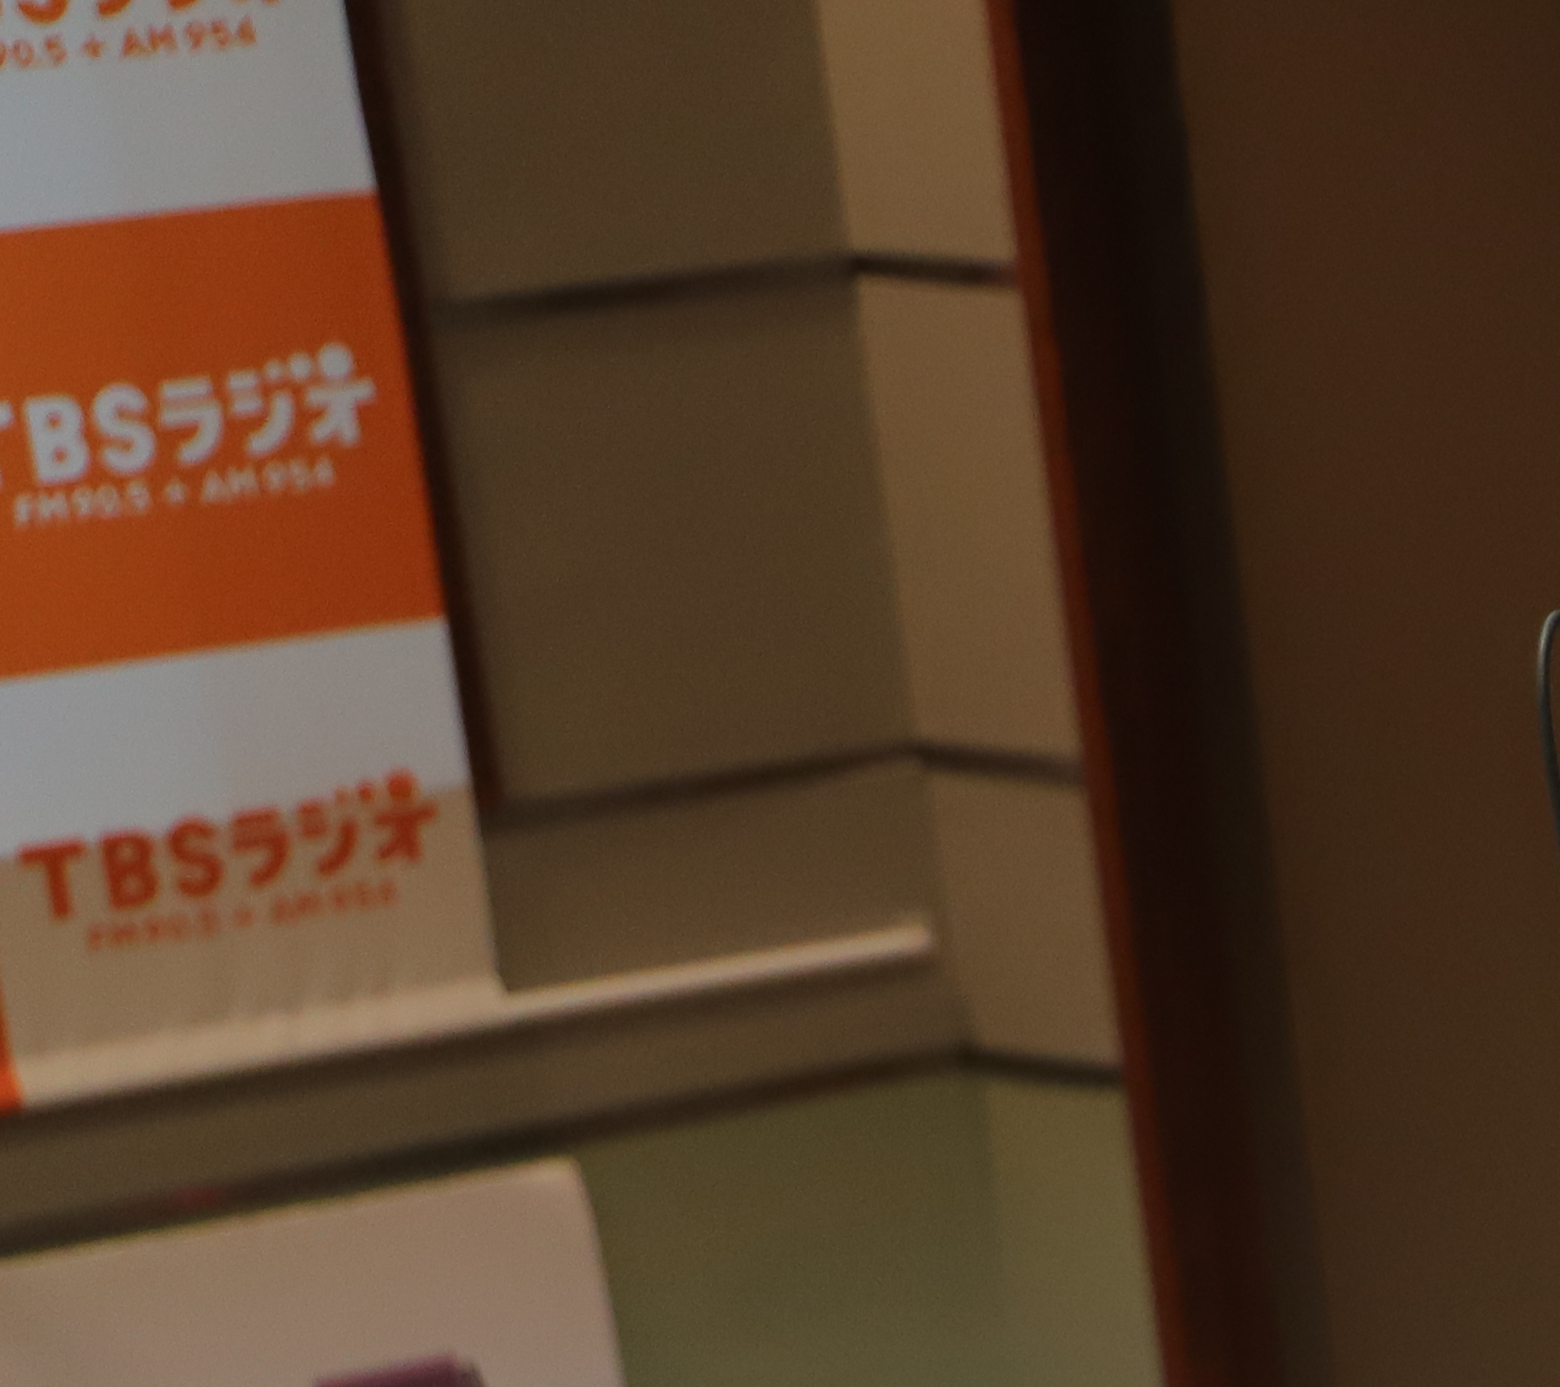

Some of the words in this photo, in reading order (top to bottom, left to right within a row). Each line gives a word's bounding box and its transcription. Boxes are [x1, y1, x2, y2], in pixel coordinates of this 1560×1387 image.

[0, 32, 68, 68] 0.5
[0, 341, 378, 485] BSラジオ
[15, 768, 438, 922] TBSラジオ
